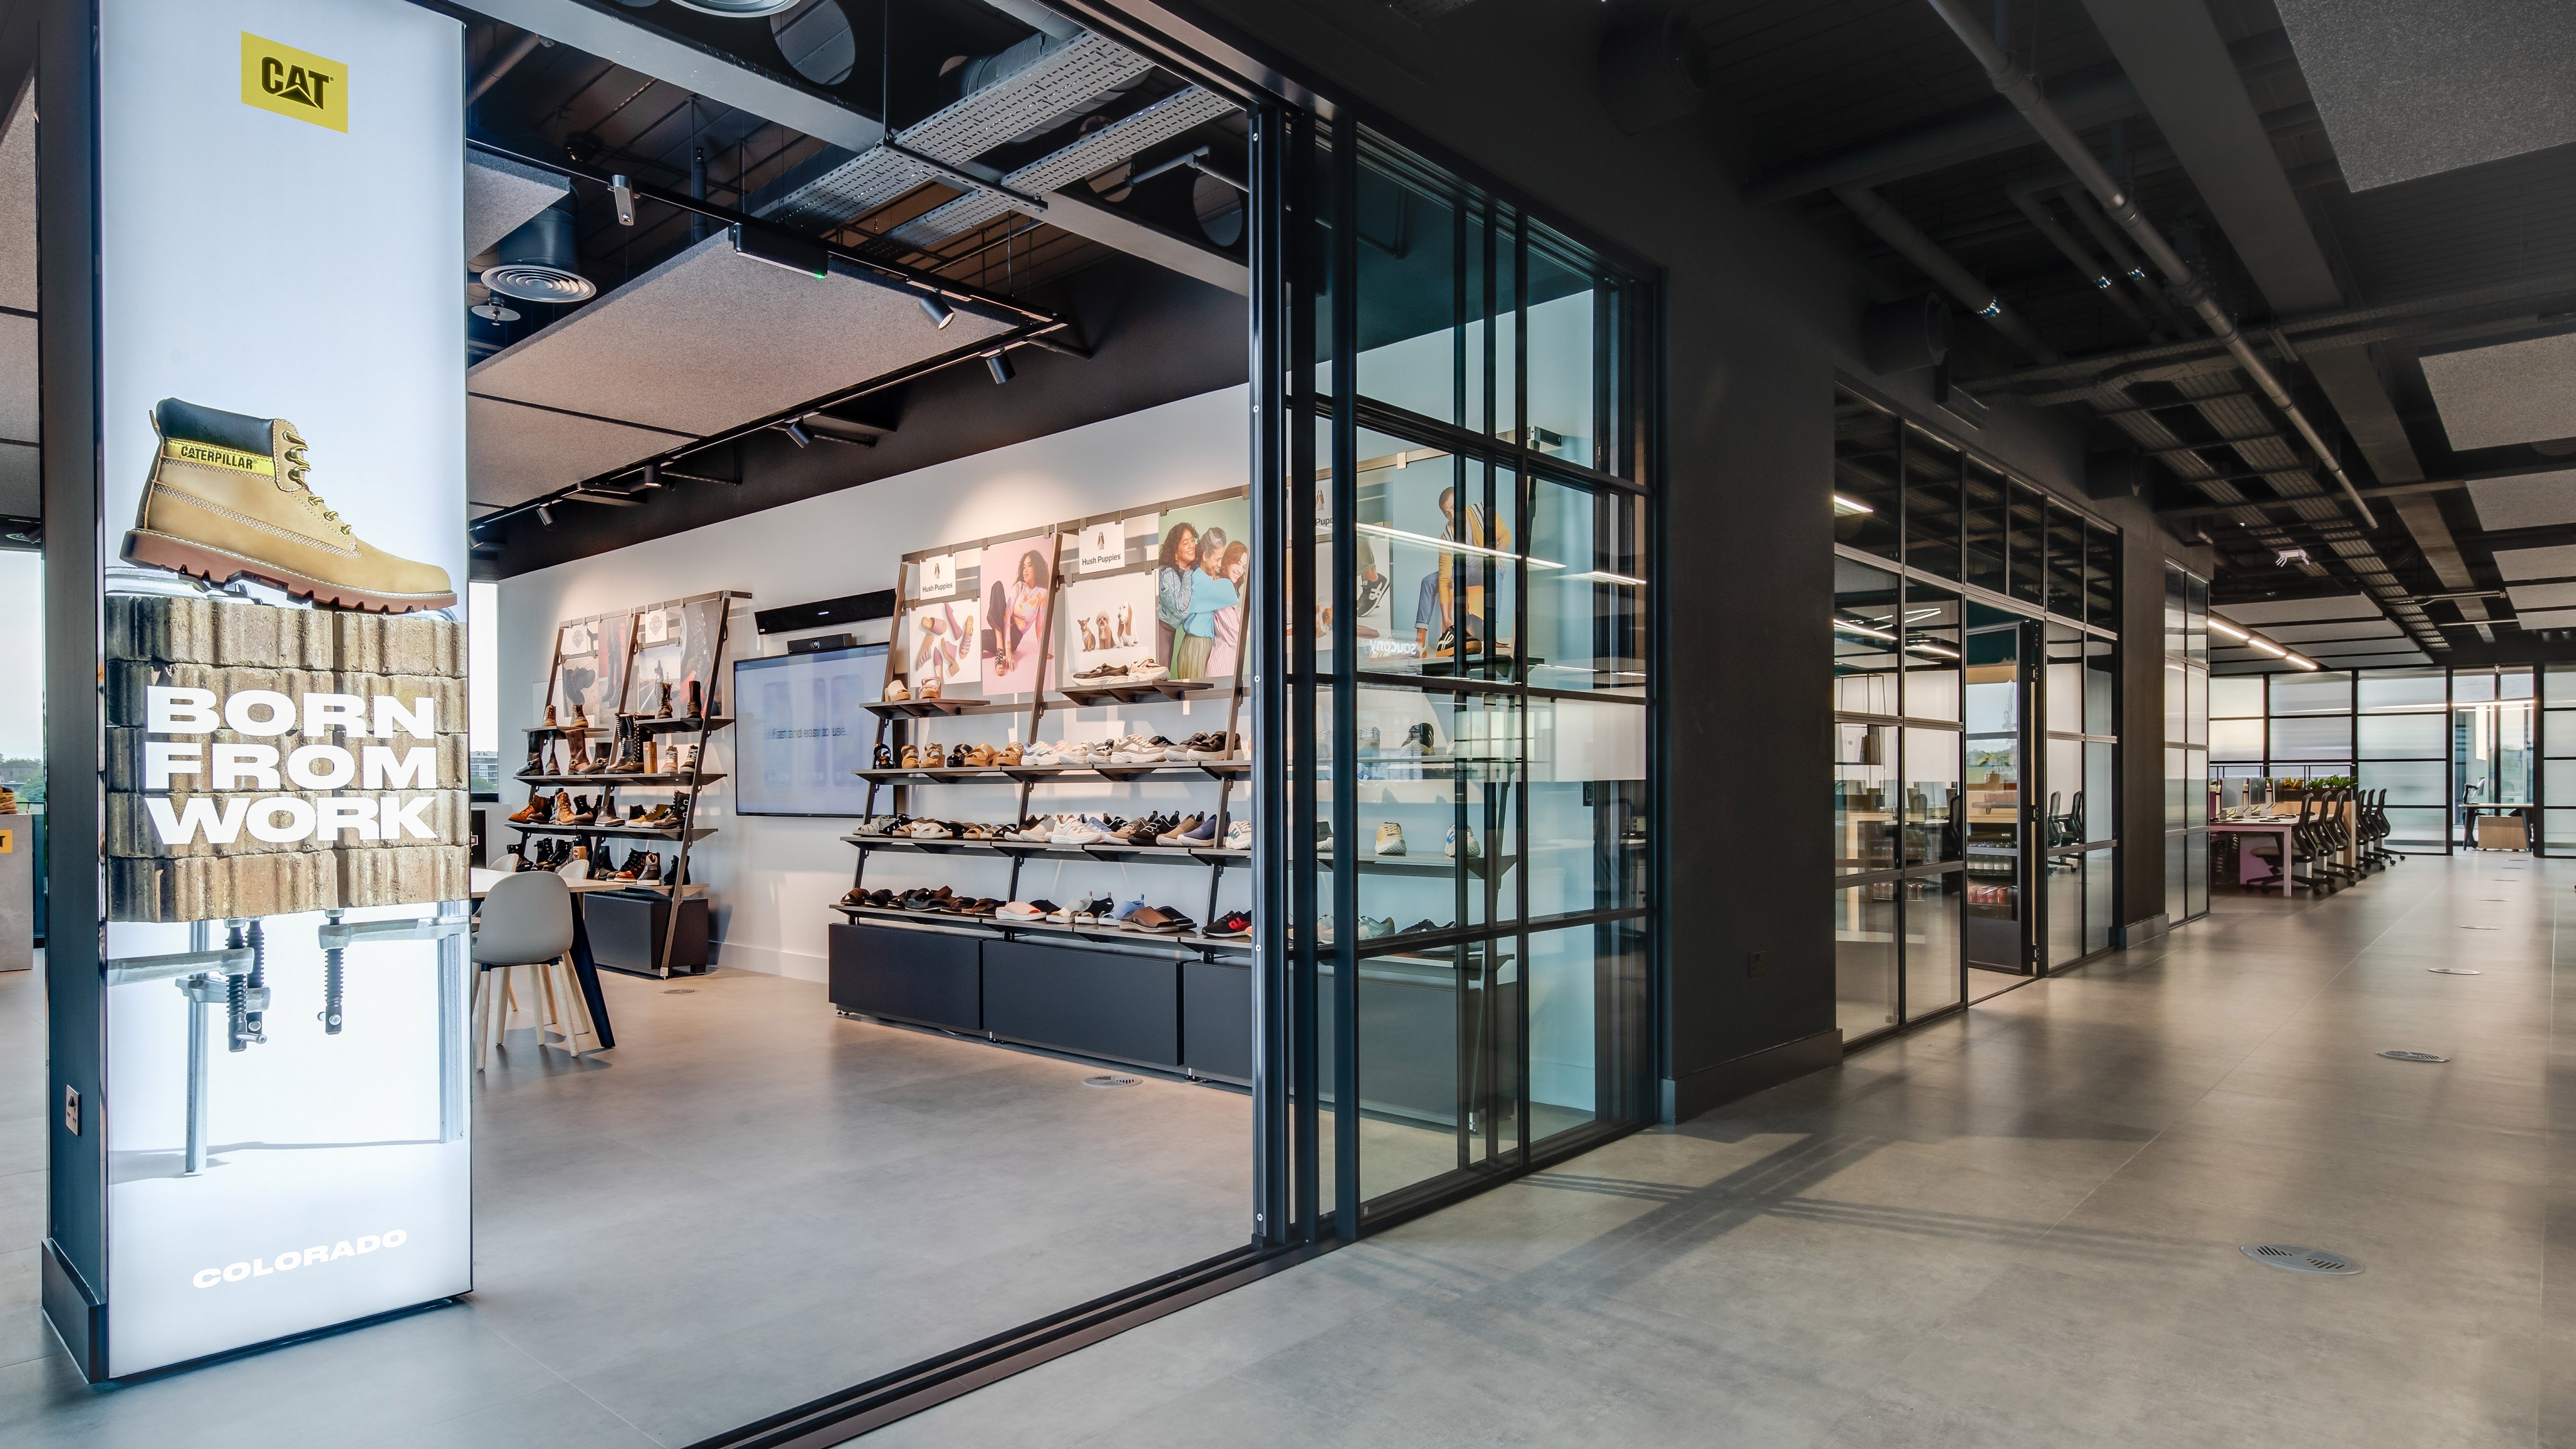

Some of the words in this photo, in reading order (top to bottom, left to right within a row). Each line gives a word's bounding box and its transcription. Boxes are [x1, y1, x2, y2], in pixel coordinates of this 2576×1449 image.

[181, 446, 253, 469] CATERPILLAR
[1082, 557, 1096, 565] Hush
[1097, 554, 1121, 564] Puppies
[934, 582, 953, 591] Puppies
[147, 686, 434, 739] BORN
[772, 728, 786, 739] Fast
[789, 727, 802, 739] and
[804, 728, 820, 741] easy
[822, 726, 830, 737] to
[145, 741, 437, 790] FROM
[146, 796, 440, 845] WORK
[193, 1229, 407, 1289] COLORADO
